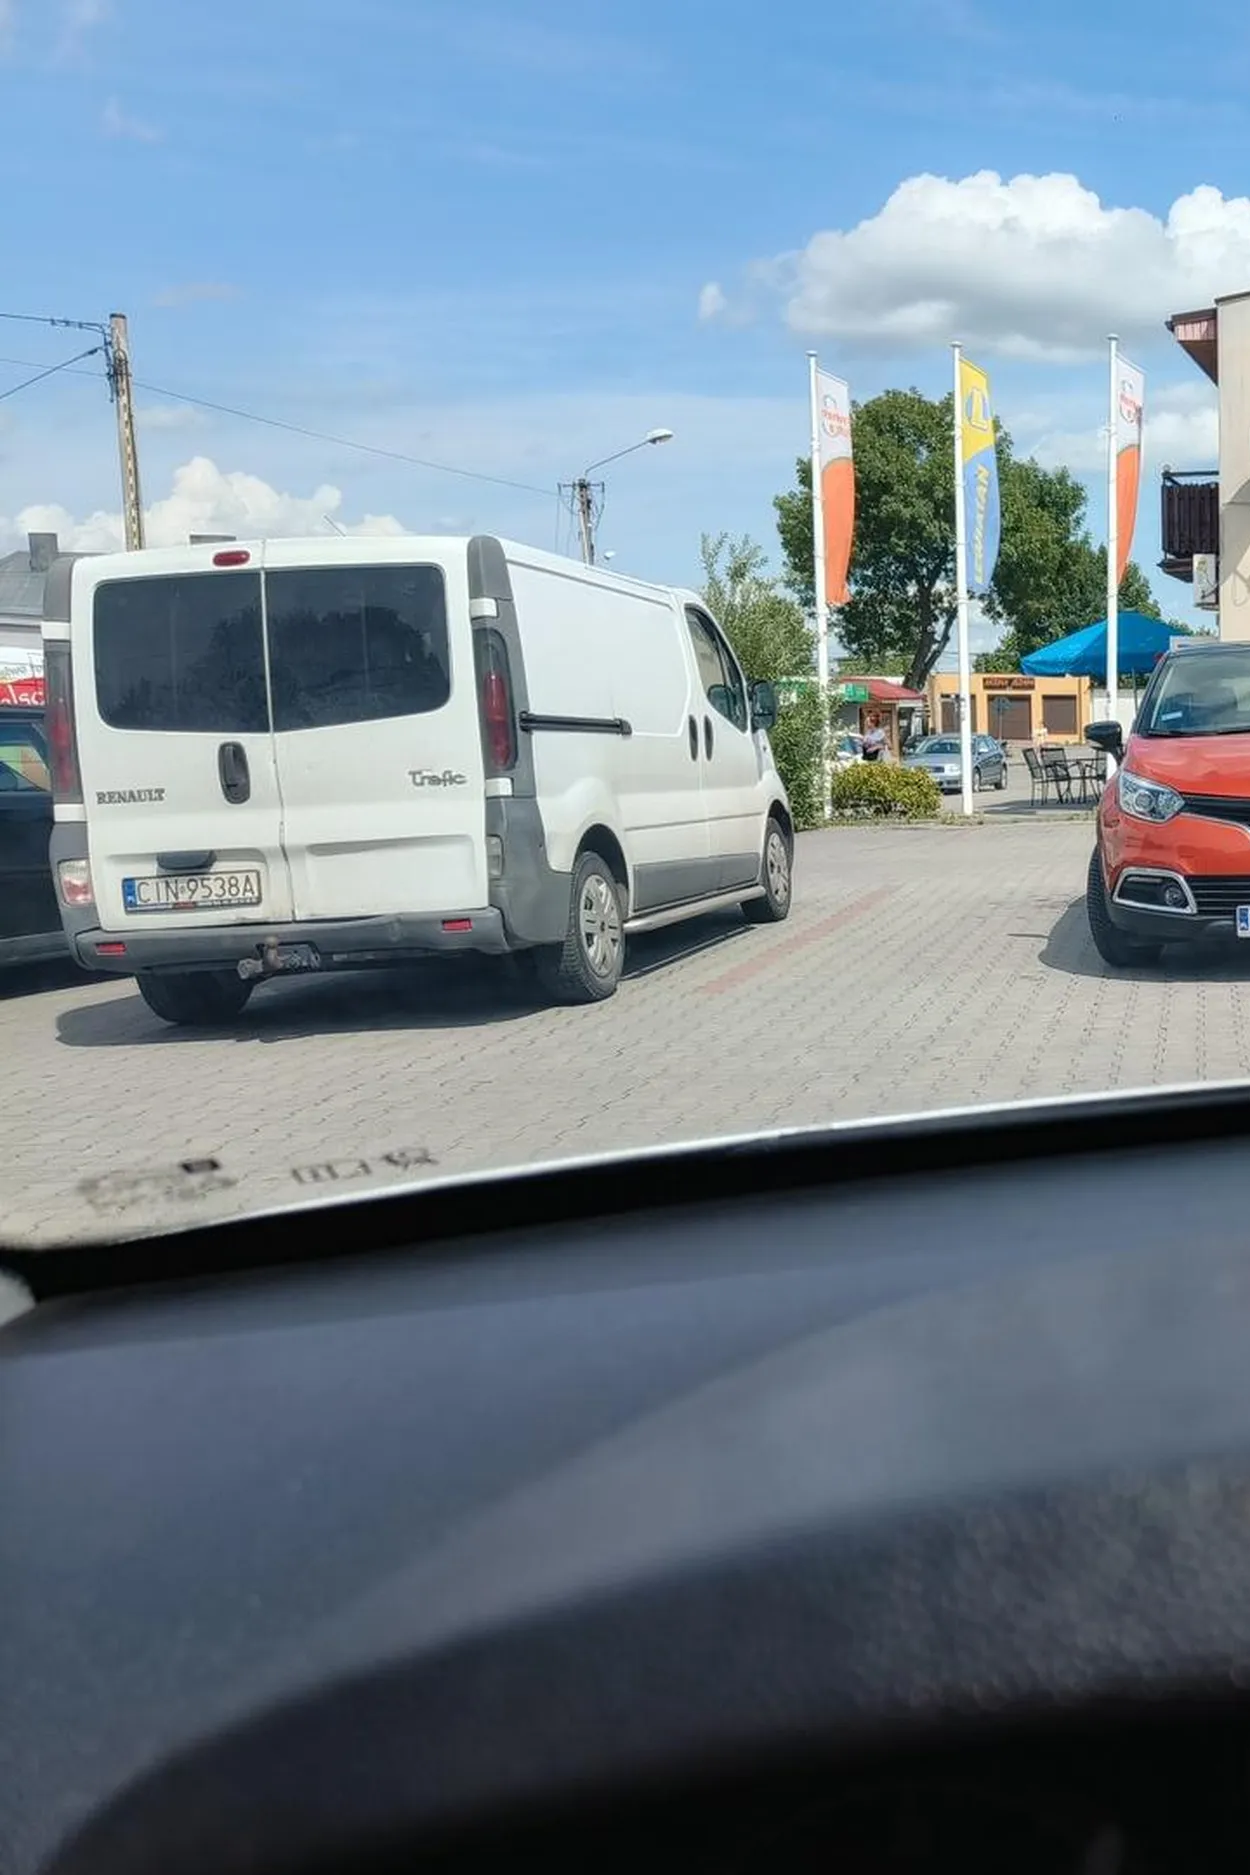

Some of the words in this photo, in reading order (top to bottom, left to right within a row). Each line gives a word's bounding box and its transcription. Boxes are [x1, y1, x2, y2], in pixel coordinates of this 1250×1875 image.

[96, 788, 165, 804] RENAULT
[137, 880, 179, 903] CIN
[186, 875, 255, 900] 9538A
